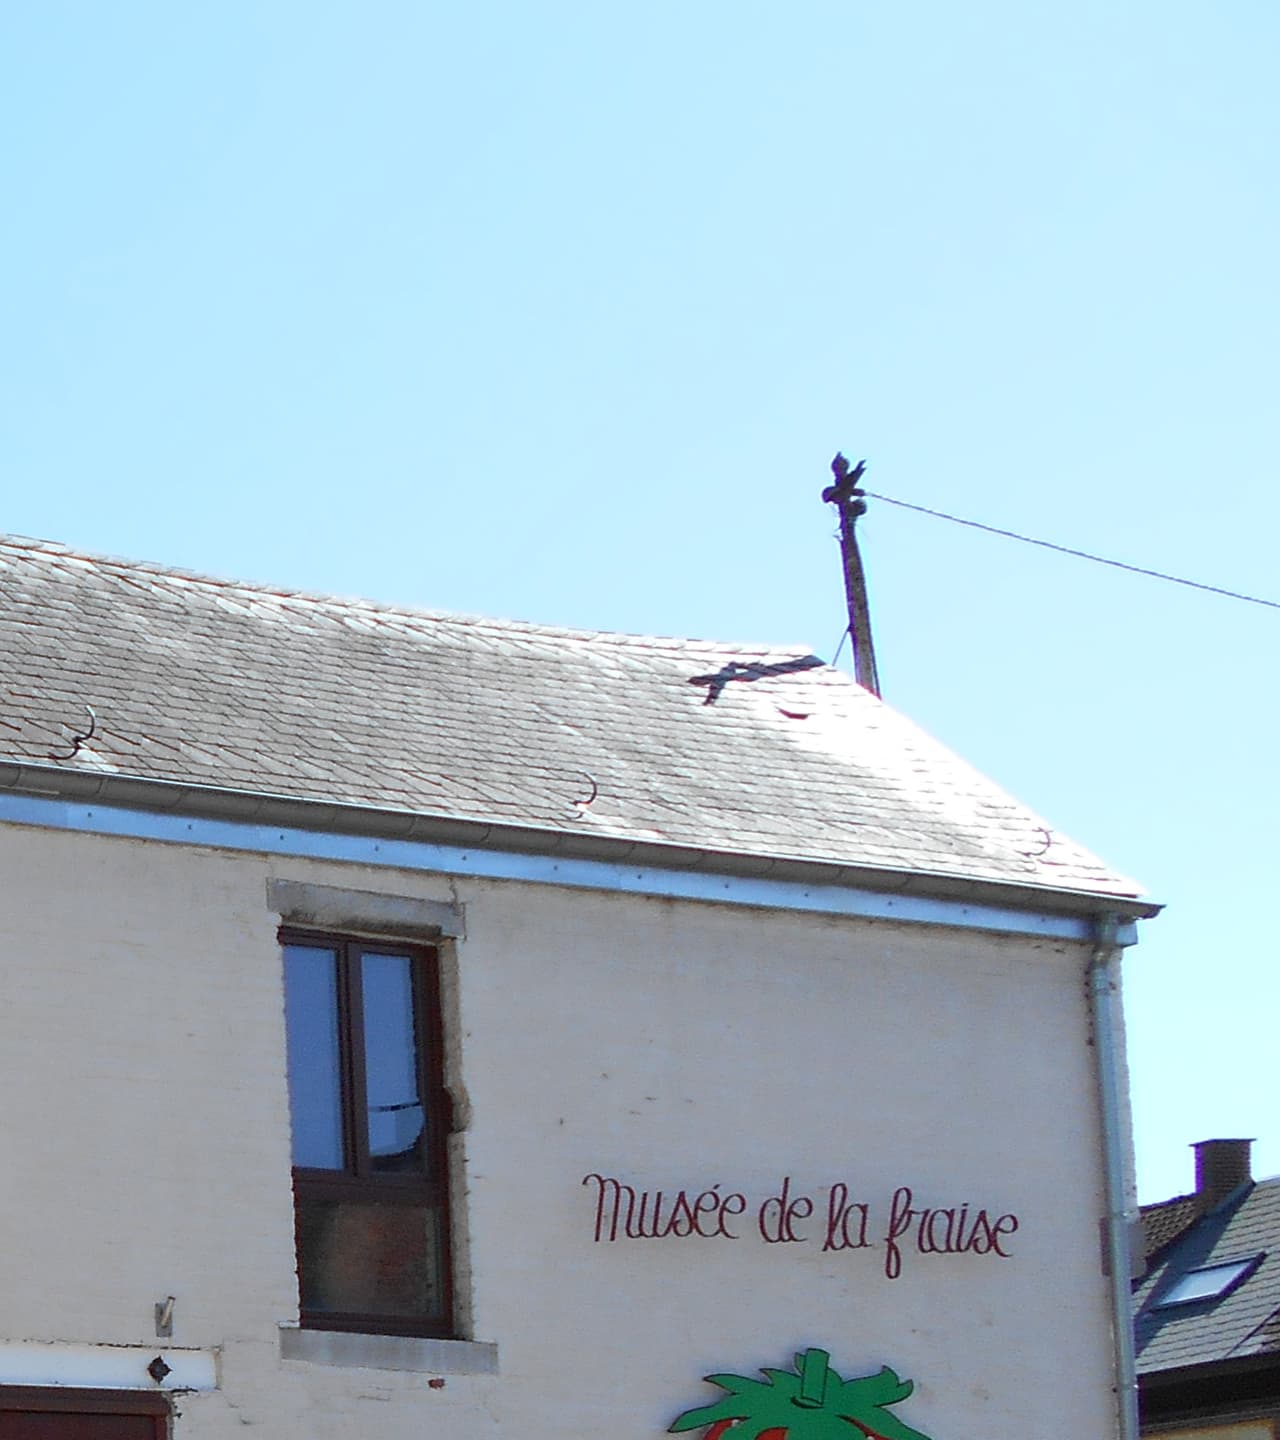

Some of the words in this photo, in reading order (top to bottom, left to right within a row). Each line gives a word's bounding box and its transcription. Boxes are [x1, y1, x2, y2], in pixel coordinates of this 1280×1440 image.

[582, 1173, 746, 1242] Musée
[758, 1176, 814, 1244] de
[821, 1182, 873, 1252] la
[883, 1186, 1019, 1280] fraise
